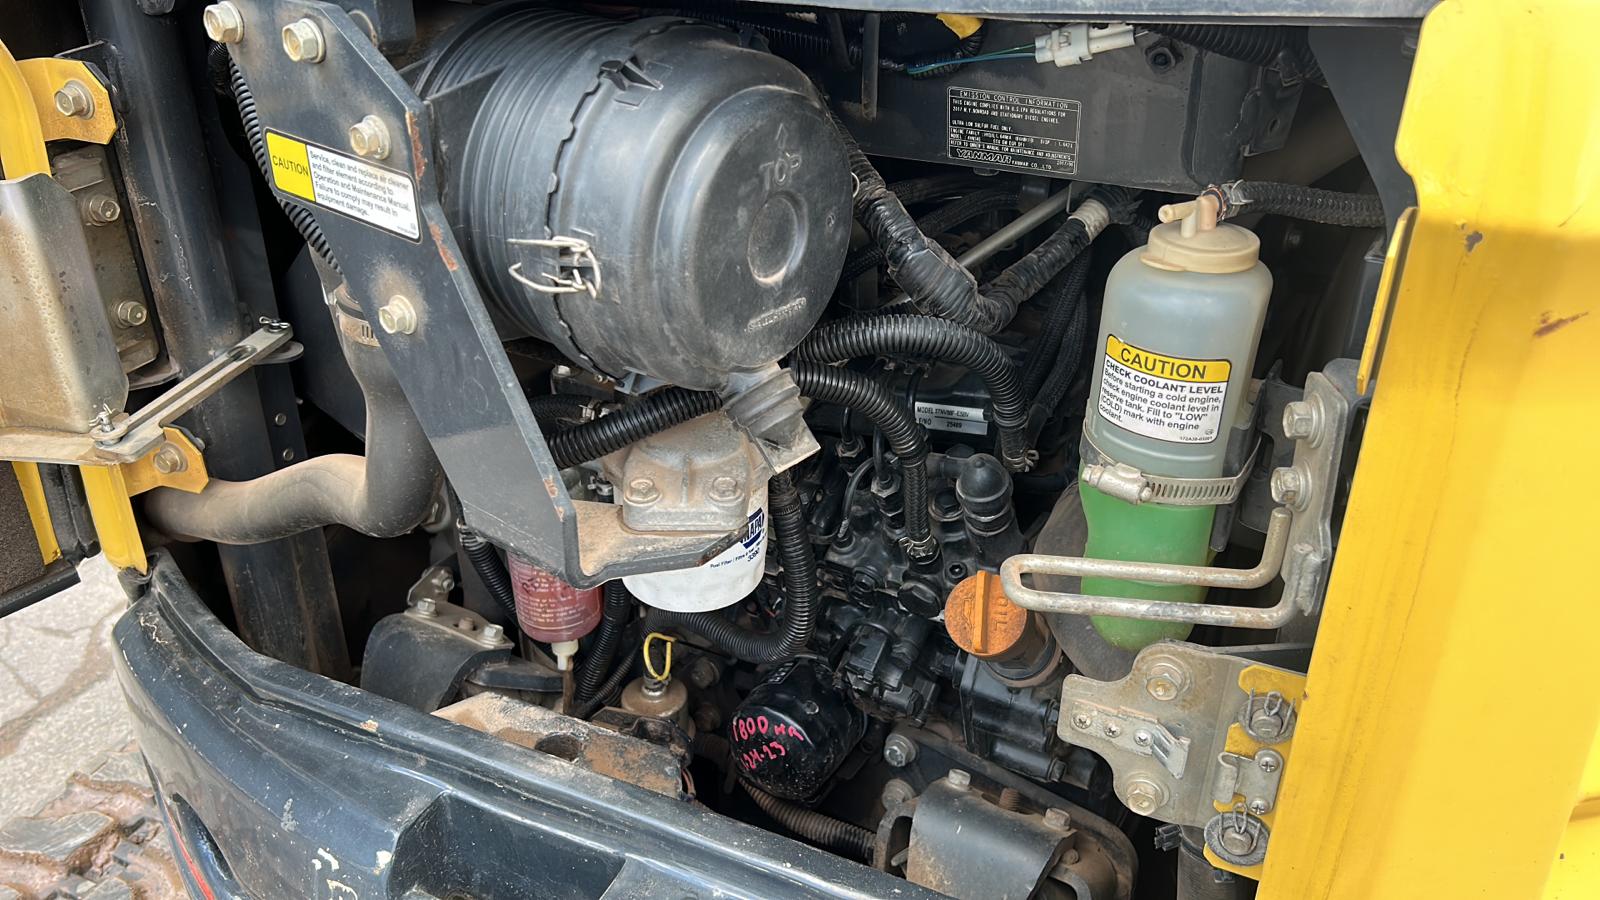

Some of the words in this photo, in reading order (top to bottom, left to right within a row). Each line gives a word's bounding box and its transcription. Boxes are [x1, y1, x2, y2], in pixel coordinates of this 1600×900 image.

[960, 90, 990, 100] EMISSION
[994, 94, 1020, 104] CONTROL
[1025, 98, 1068, 109] INFORMATION
[980, 102, 998, 110] COMPLIES
[1030, 107, 1056, 116] REGULATIONS
[999, 111, 1023, 119] STATIONARY
[1025, 114, 1039, 122] DIESEL
[272, 155, 309, 177] CAUTION
[310, 150, 331, 165] Service,
[331, 159, 346, 170] clean
[347, 164, 358, 174] and
[358, 168, 379, 181] replace
[388, 177, 409, 191] cleaner
[759, 152, 802, 192] TOP
[956, 148, 1012, 164] YANMAR
[312, 162, 322, 171] and
[322, 164, 335, 174] filter
[335, 169, 358, 183] element
[358, 178, 387, 195] according
[387, 186, 394, 196] to
[313, 170, 340, 186] Operation
[340, 181, 351, 191] and
[351, 183, 388, 204] Maintenance
[315, 180, 333, 194] Failure
[333, 187, 340, 196] to
[340, 191, 361, 206] comply
[361, 199, 374, 210] may
[374, 203, 391, 215] result
[391, 208, 398, 217] in
[317, 191, 346, 208] equipment
[1105, 359, 1131, 380] CHECK
[1133, 374, 1187, 393] COOLANT
[1189, 386, 1224, 394] LEVEL
[1120, 347, 1207, 380] CAUTION
[1101, 386, 1124, 403] reserve
[1125, 399, 1145, 413] tank.
[1146, 406, 1161, 418] Fill
[1162, 411, 1173, 420] to
[1103, 378, 1120, 393] check
[1121, 389, 1148, 404] engine
[1150, 398, 1186, 412] coolant
[1187, 404, 1210, 413] level
[1210, 403, 1220, 413] in
[1104, 367, 1124, 386] Before
[1124, 381, 1156, 399] starting
[1165, 393, 1187, 403] cold
[1188, 395, 1221, 405] engine,
[916, 406, 934, 415] MODEL
[1099, 403, 1123, 423] coolant.
[1100, 393, 1123, 414] (COLD)
[1123, 408, 1144, 422] mark
[1145, 416, 1165, 427] with
[1167, 421, 1200, 431] engine
[991, 596, 1008, 632] OIL
